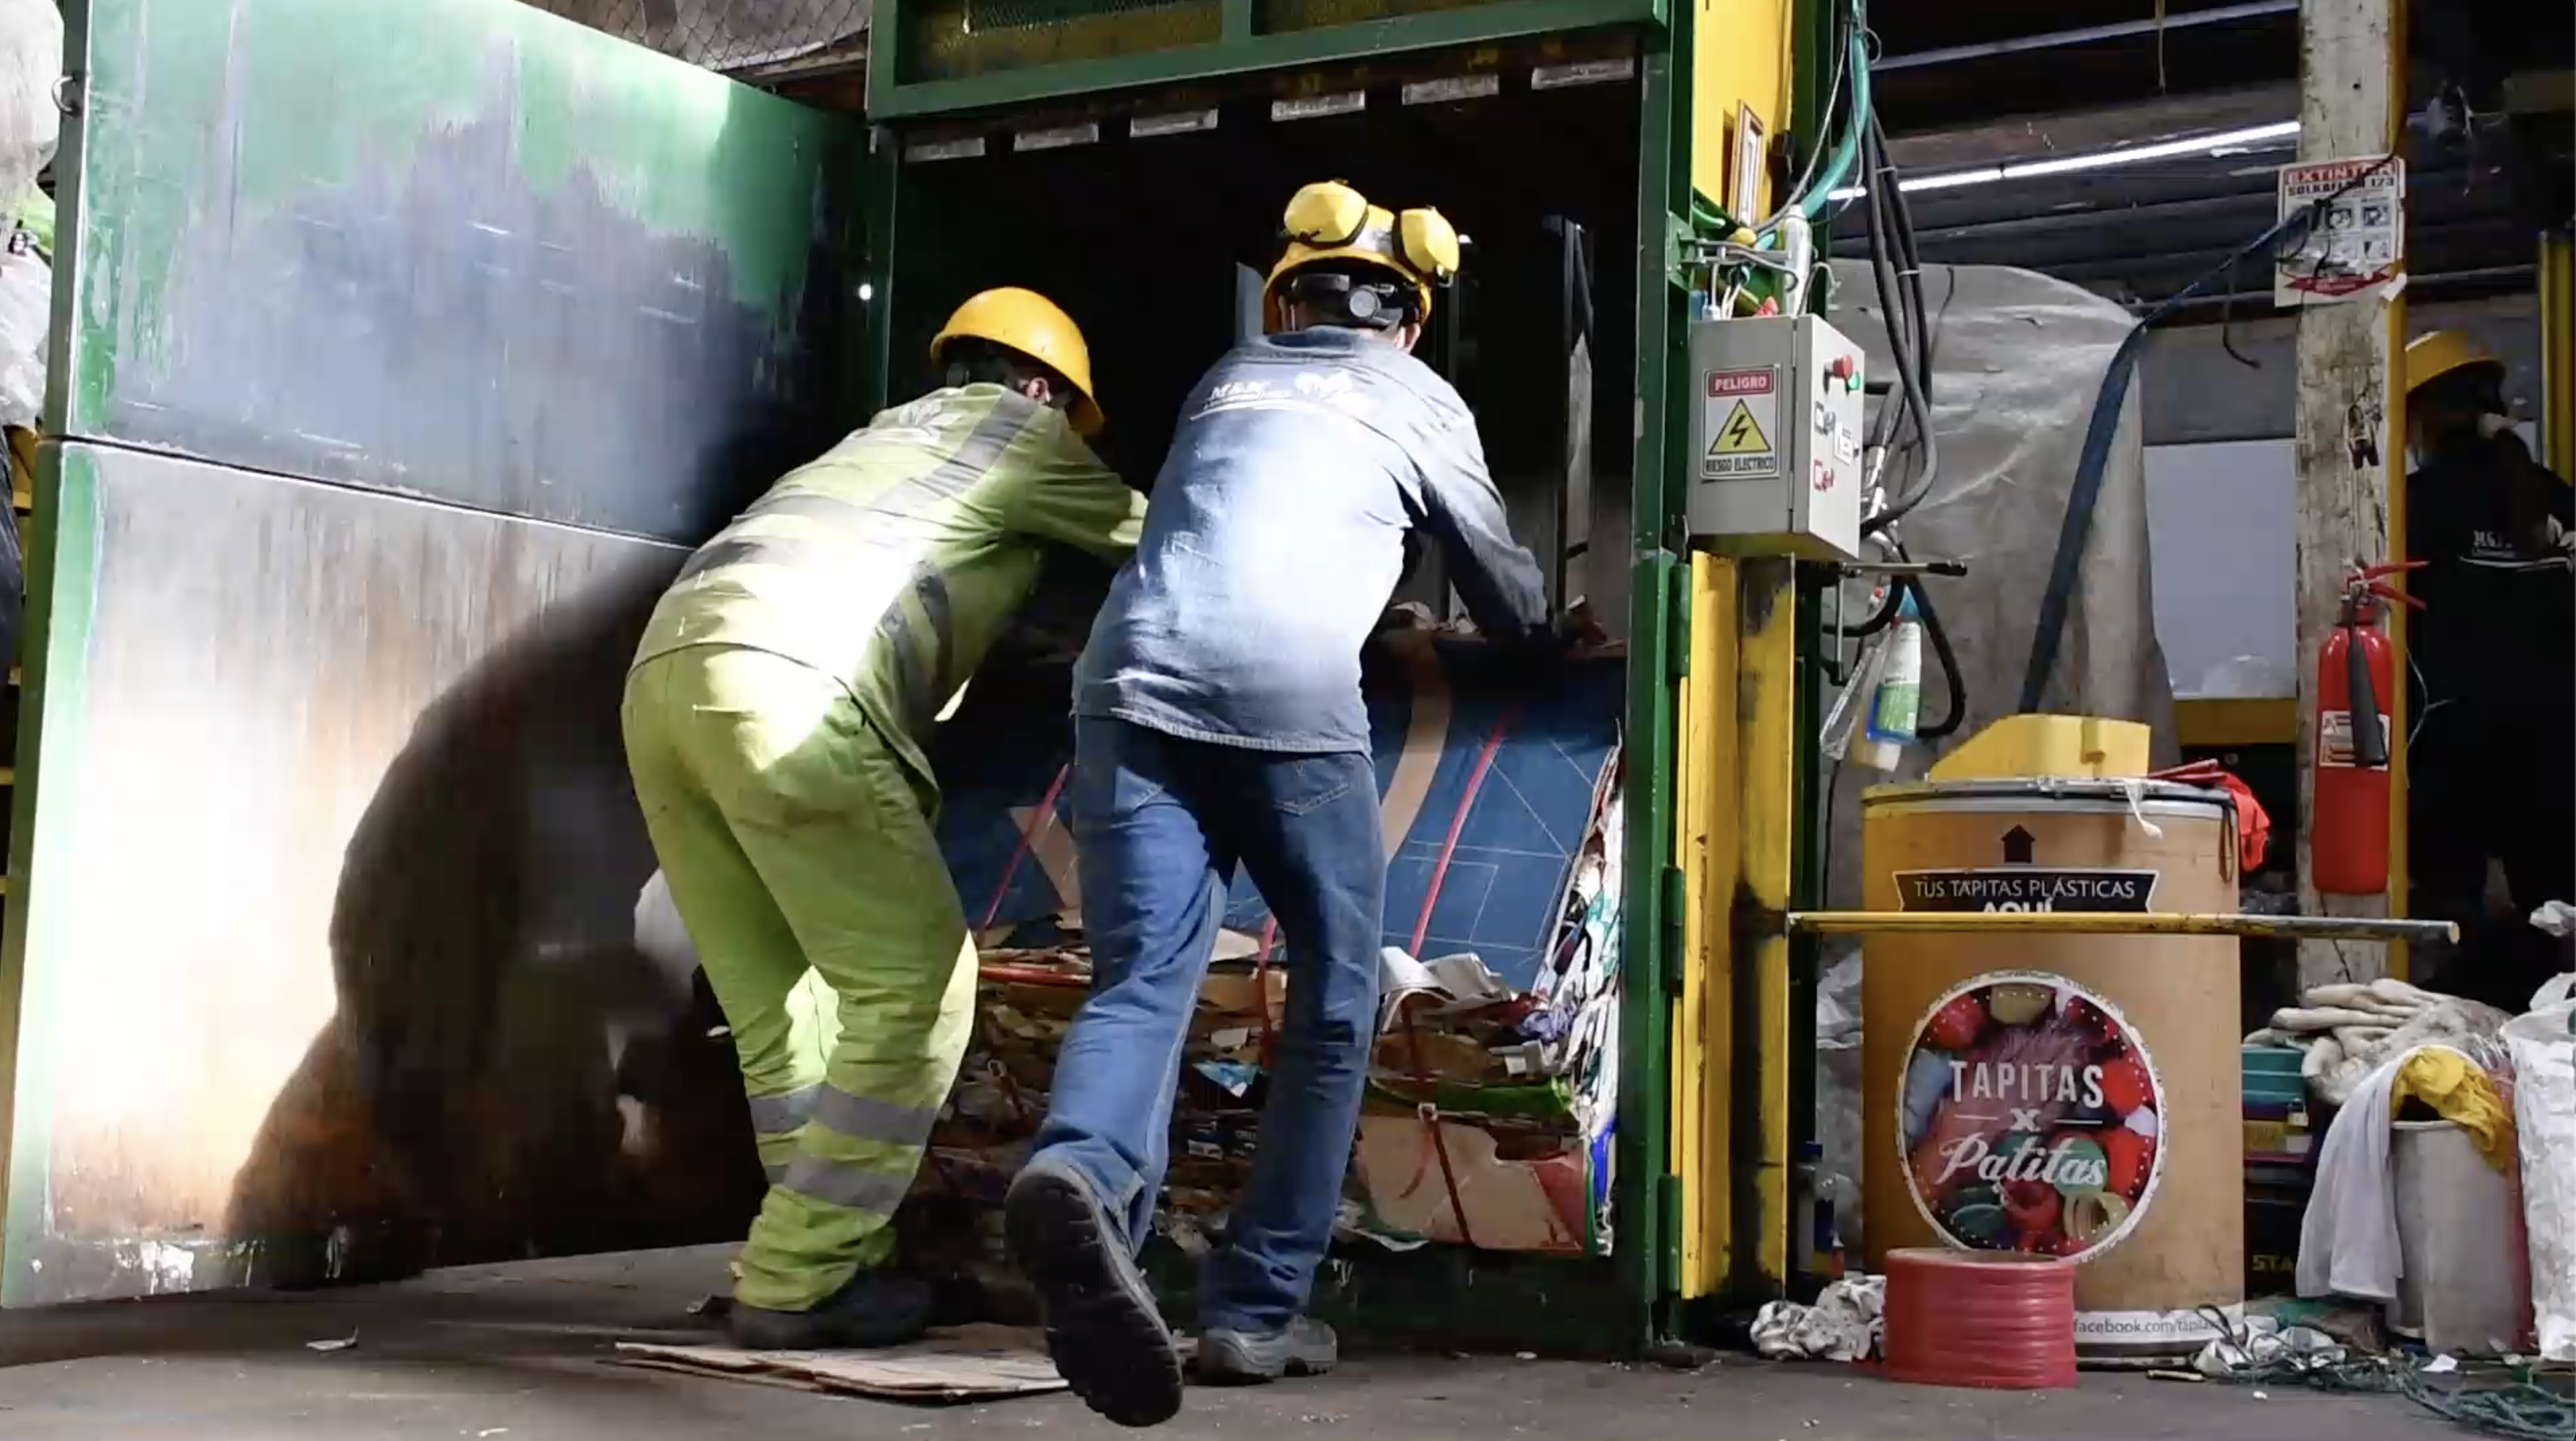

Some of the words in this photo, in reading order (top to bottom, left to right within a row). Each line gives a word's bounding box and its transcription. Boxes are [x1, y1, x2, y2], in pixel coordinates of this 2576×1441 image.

[1715, 377, 1768, 391] PELIGRO
[1706, 459, 1733, 472] RIESGO
[1914, 880, 1945, 898] TUS
[1949, 879, 2023, 897] TAPITAS
[2029, 877, 2135, 899] PLÁSTICAS
[1948, 1060, 2104, 1108] TAPITAS
[1935, 1132, 2106, 1185] Patitas
